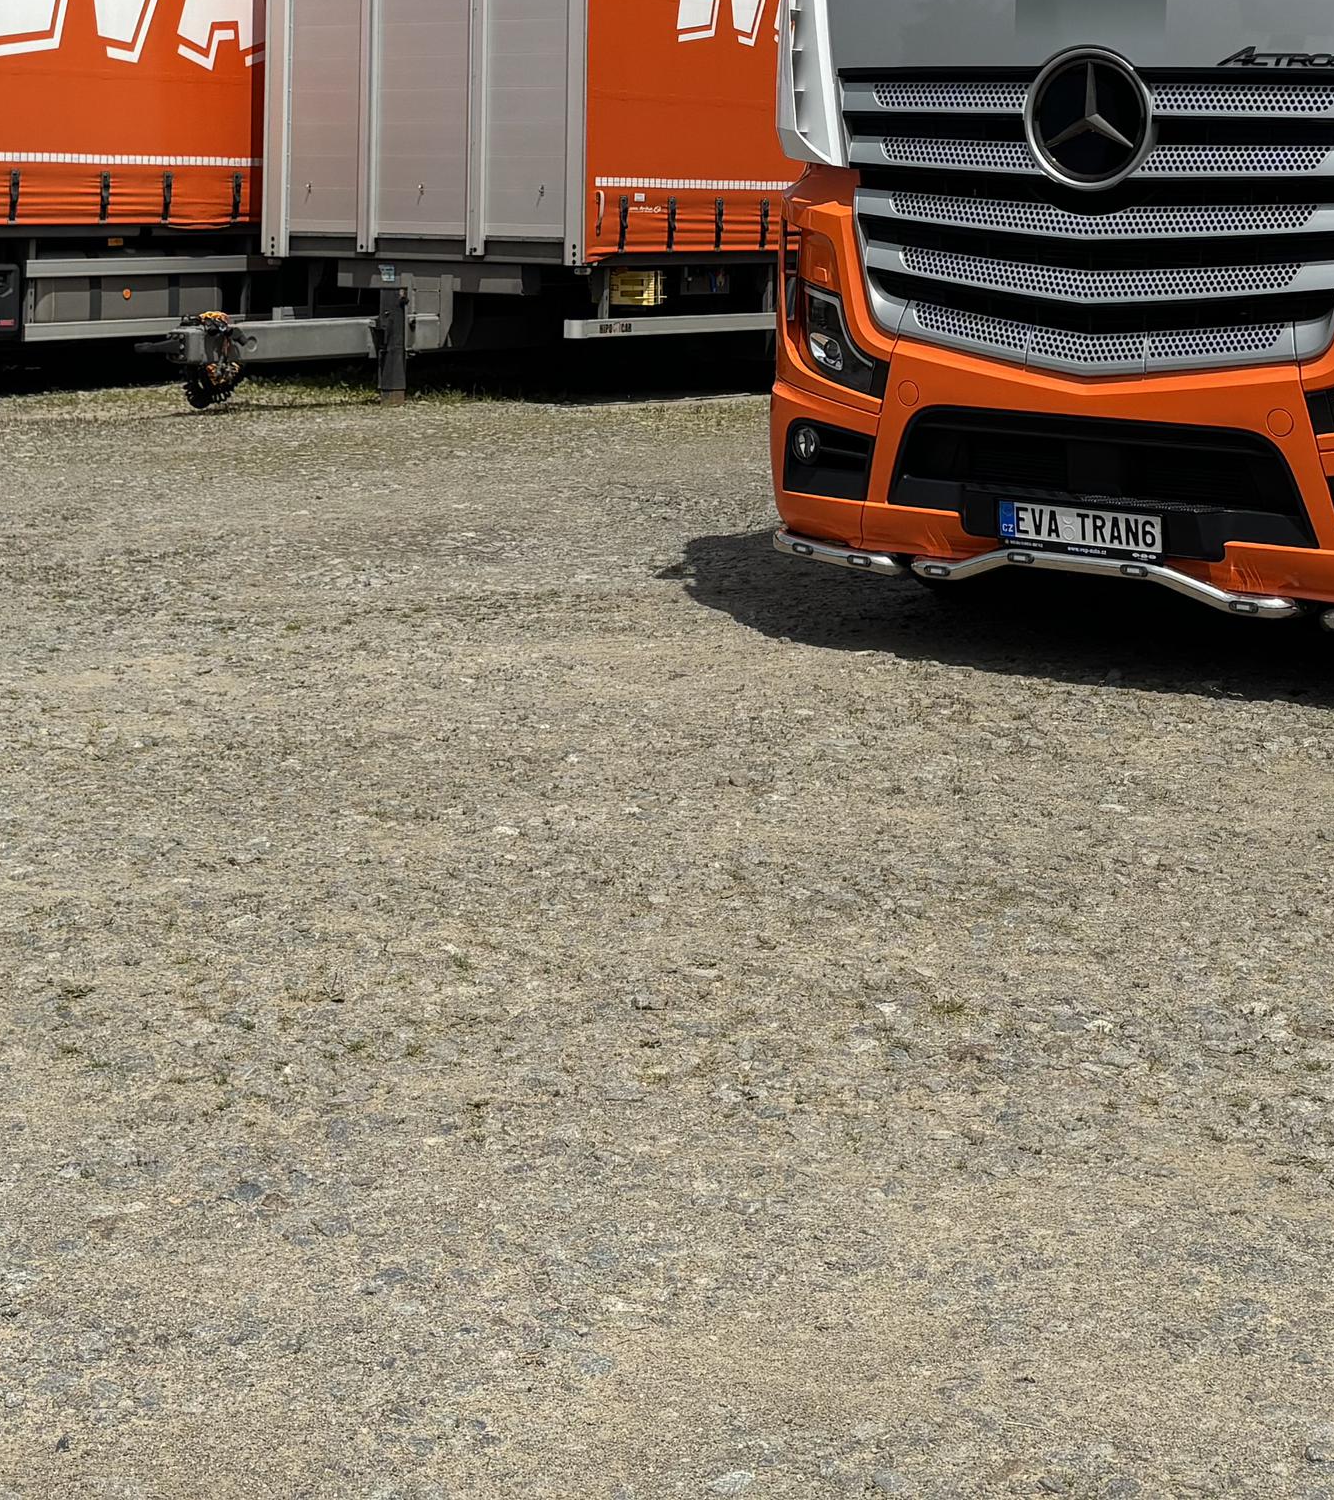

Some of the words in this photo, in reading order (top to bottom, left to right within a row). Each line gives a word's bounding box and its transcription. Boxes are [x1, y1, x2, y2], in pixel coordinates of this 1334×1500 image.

[1002, 523, 1014, 533] CZ
[1016, 506, 1061, 539] EVA
[1076, 512, 1156, 548] TRAN6
